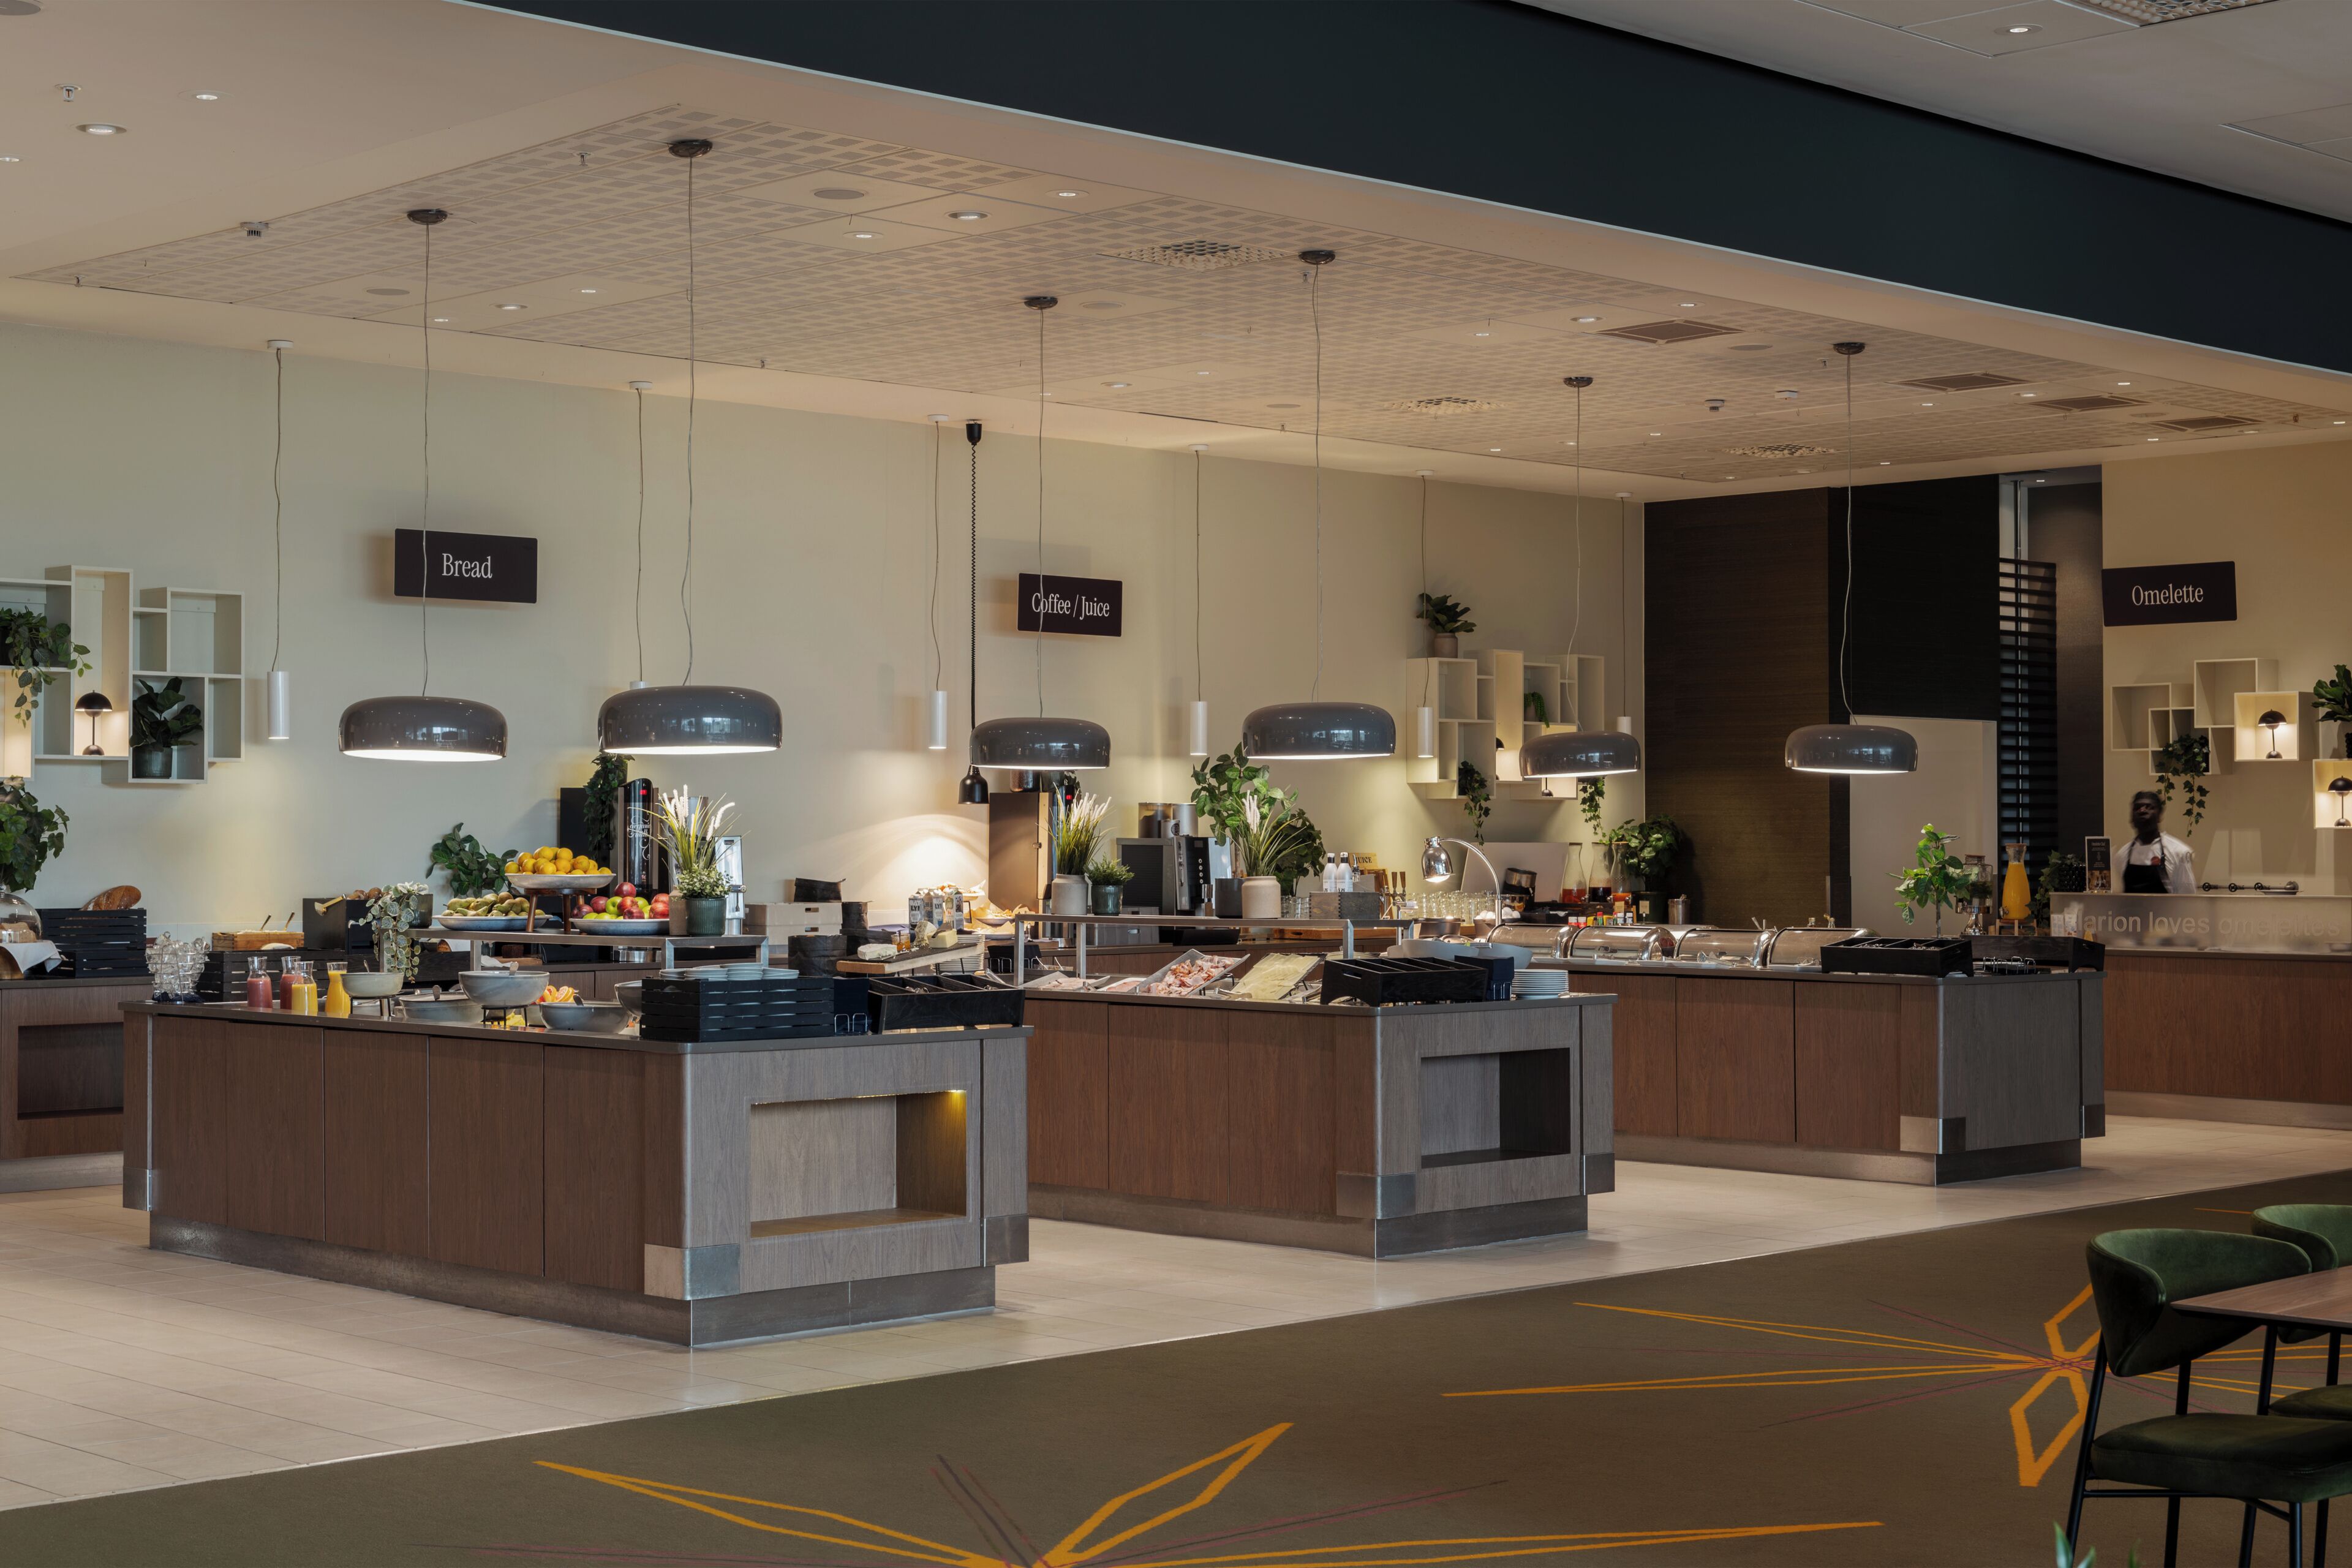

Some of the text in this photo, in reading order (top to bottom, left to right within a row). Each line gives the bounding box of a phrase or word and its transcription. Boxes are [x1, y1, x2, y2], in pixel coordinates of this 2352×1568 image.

[442, 553, 492, 578] Bread
[1031, 592, 1110, 620] Coffee / Juice
[2132, 583, 2204, 606] Omelette
[2077, 910, 2141, 932] larion
[2149, 911, 2210, 934] loves
[2218, 913, 2341, 937] omelettes
